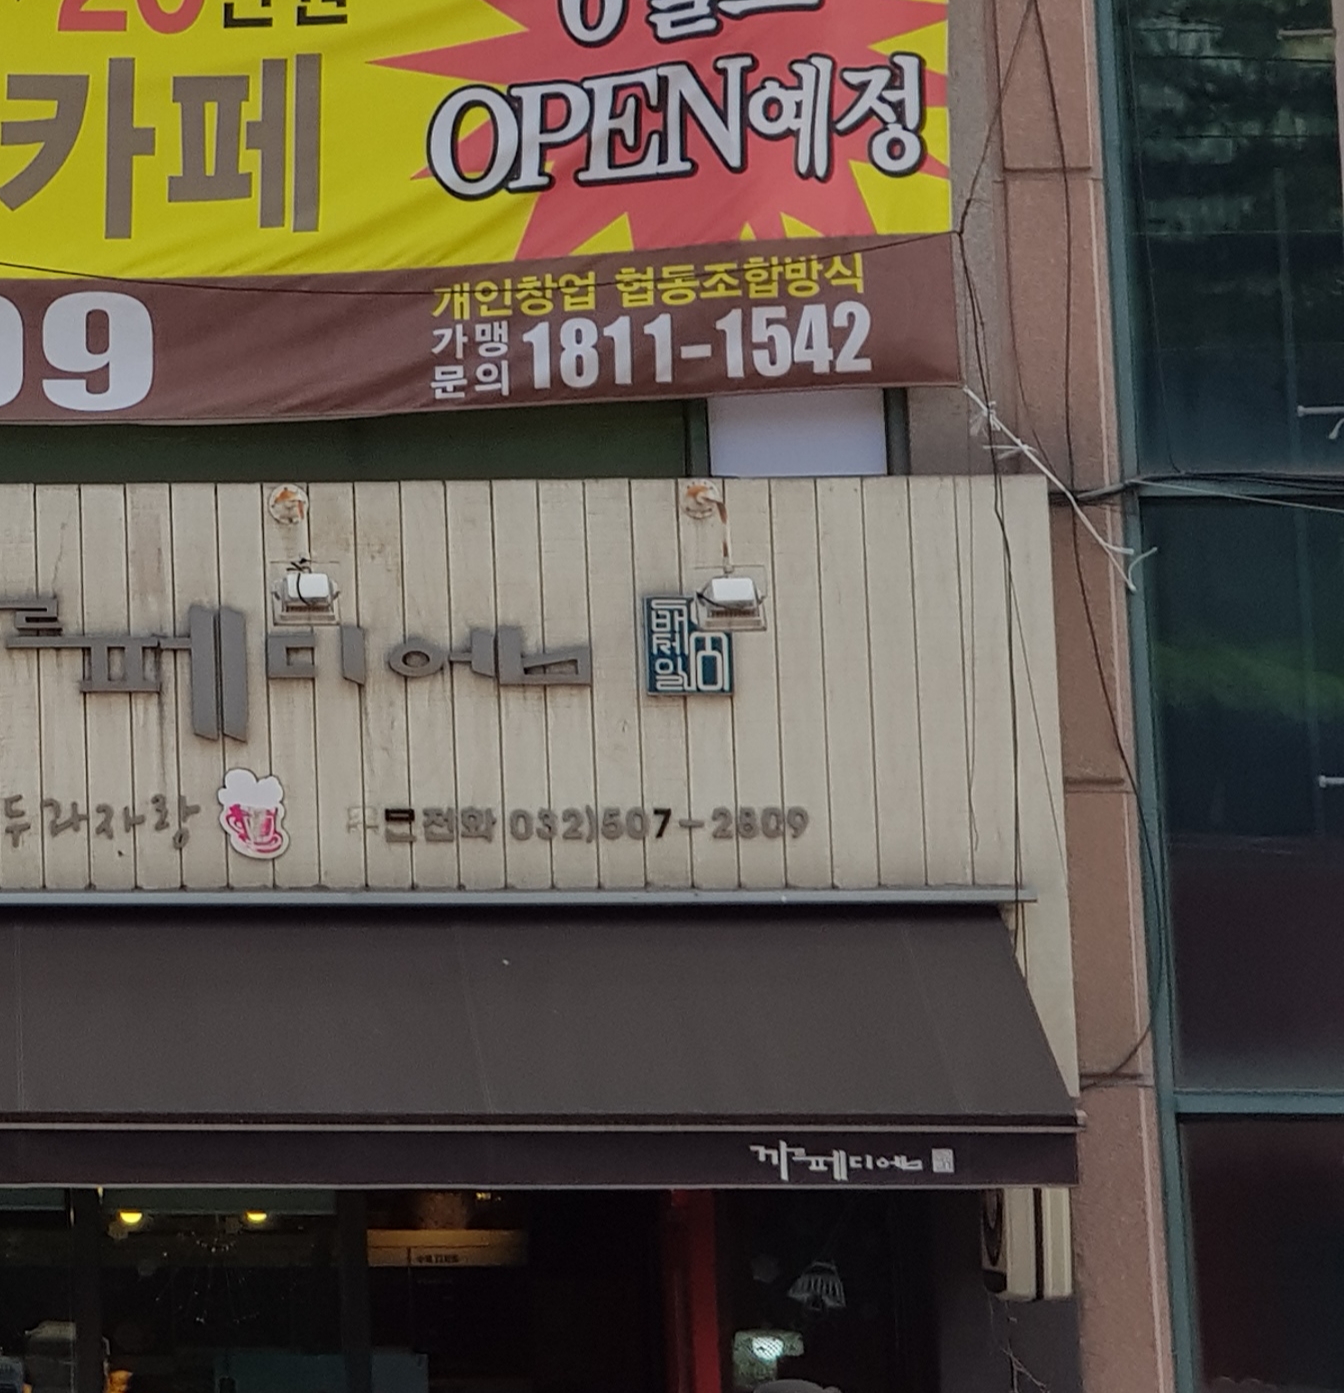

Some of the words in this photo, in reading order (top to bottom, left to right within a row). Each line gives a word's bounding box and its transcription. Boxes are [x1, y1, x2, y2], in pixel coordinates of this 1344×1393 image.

[425, 52, 926, 201] OPEN예정
[432, 271, 598, 321] 개인창업
[614, 252, 866, 309] 협동조합방식
[520, 300, 872, 390] 1811-1542
